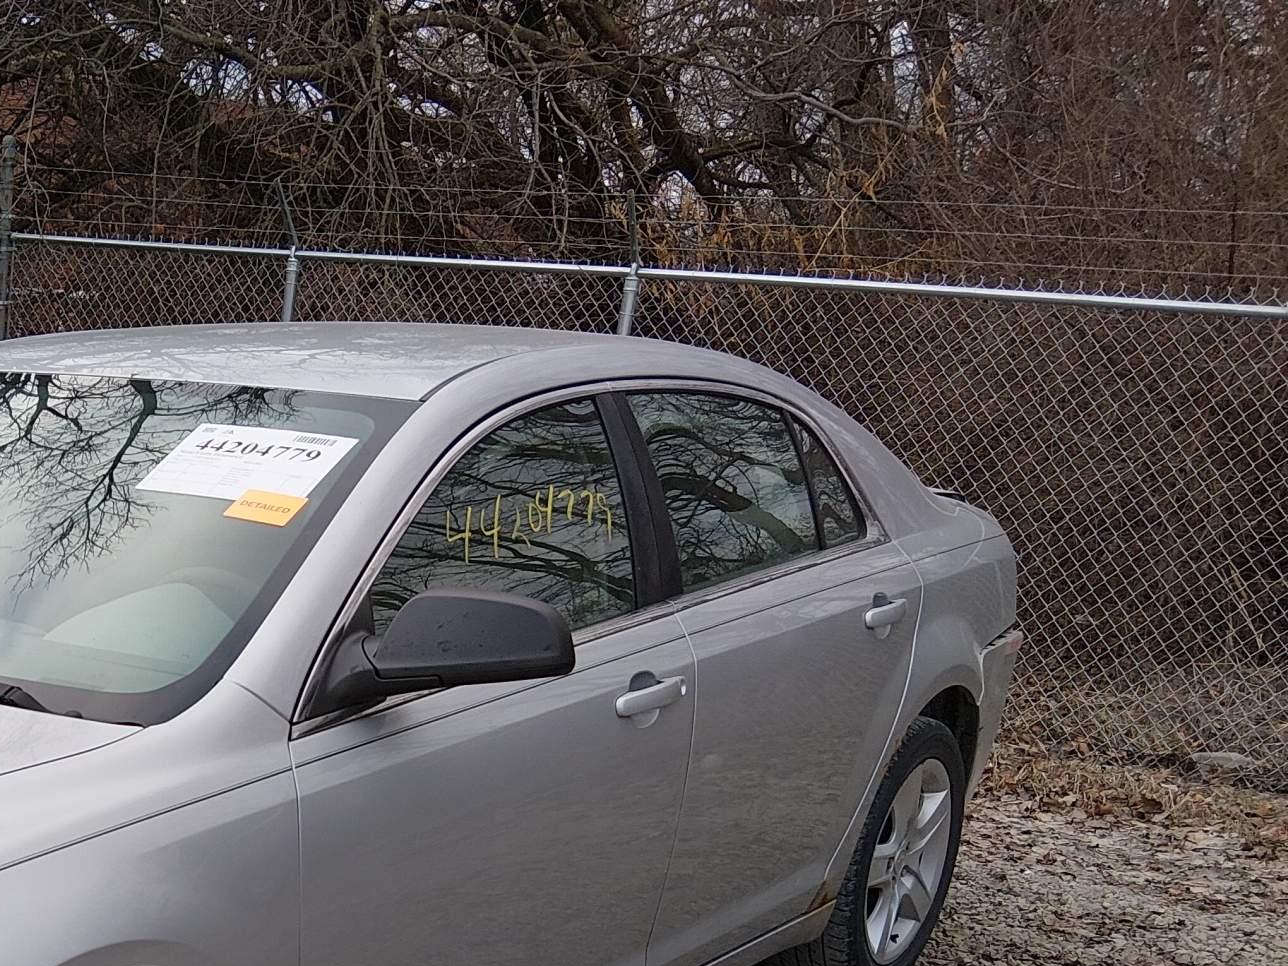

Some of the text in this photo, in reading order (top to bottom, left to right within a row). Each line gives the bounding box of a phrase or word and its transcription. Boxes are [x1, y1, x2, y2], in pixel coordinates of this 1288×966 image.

[195, 438, 322, 462] 44204779
[239, 499, 291, 515] DETAILED
[445, 483, 613, 564] 44204779
